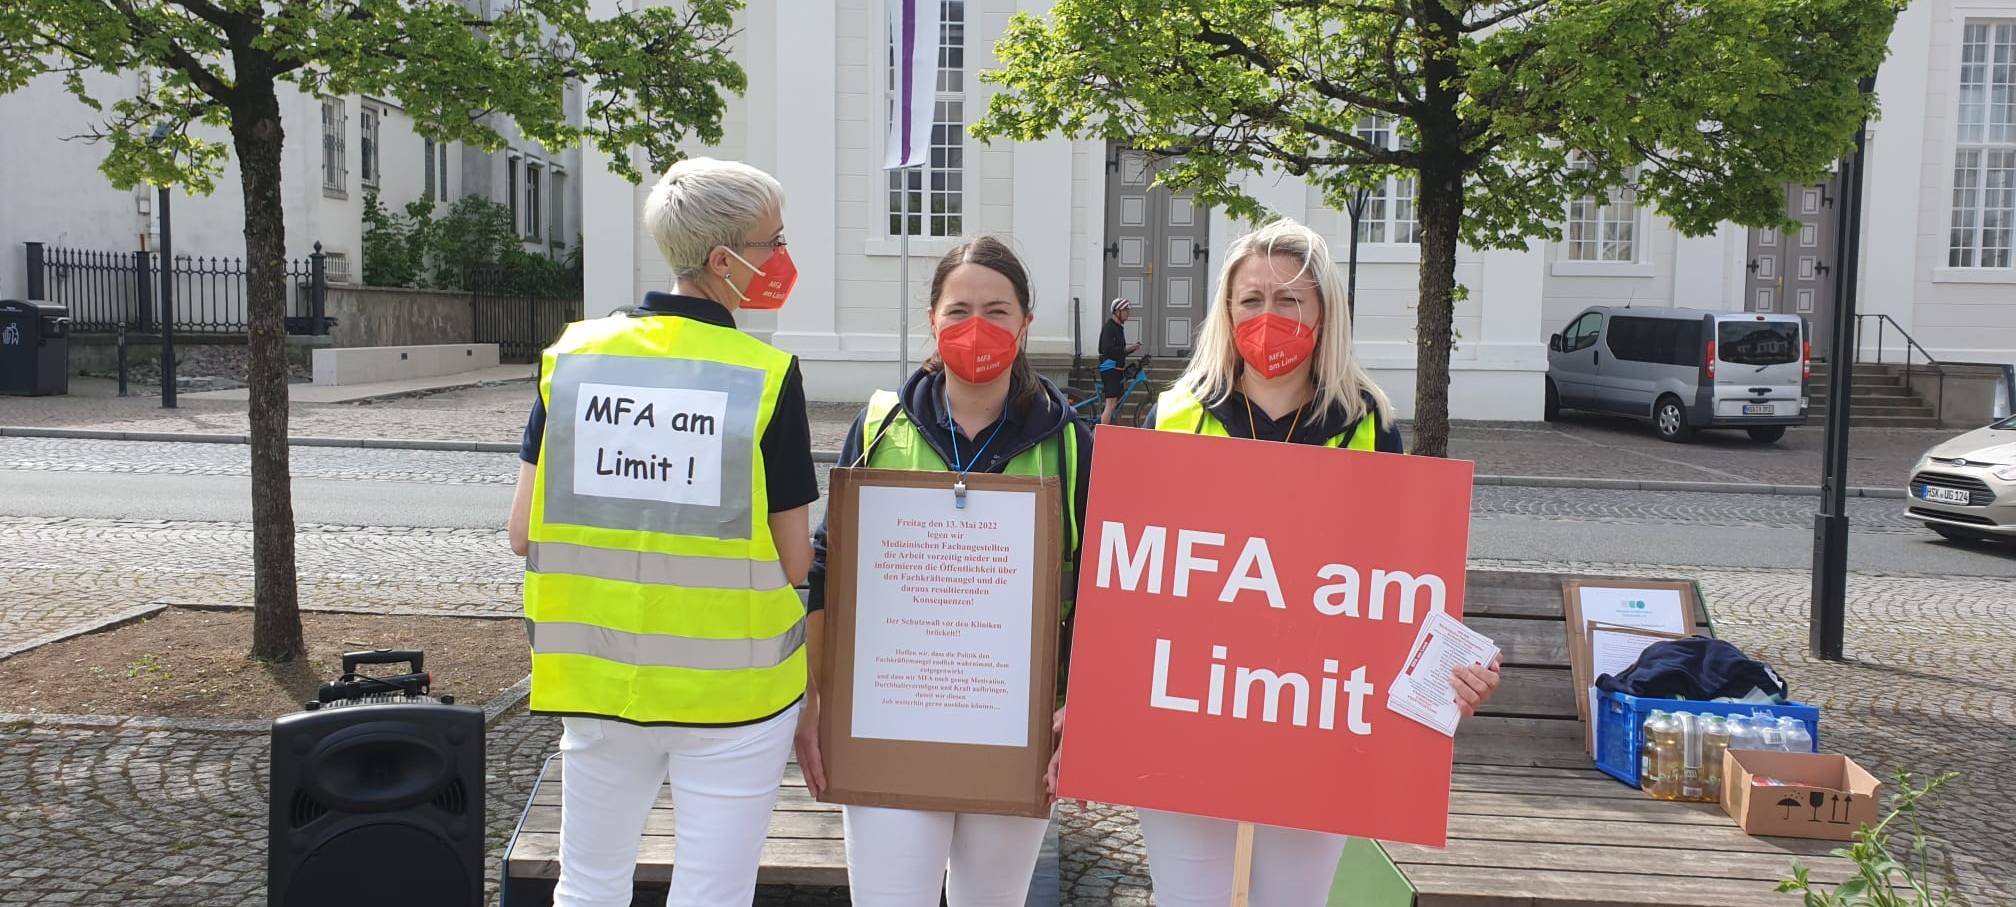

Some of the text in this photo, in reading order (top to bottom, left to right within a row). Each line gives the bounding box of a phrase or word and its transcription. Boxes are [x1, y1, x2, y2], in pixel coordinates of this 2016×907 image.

[1268, 351, 1284, 361] MFA
[585, 395, 714, 435] MFA am
[597, 447, 672, 482] Limit
[1955, 491, 1968, 502] 124
[897, 519, 926, 528] Freitag
[927, 531, 948, 540] legen
[881, 540, 1009, 552] Medizinischen Fachangestellten
[927, 553, 961, 563] vorzeitig
[874, 562, 922, 571] informieren
[940, 562, 996, 573] Öffentlichkeit
[1095, 520, 1447, 625] MFA am
[901, 574, 975, 584] Fachkräftemangel
[901, 585, 989, 595] daraus resultierenden
[913, 596, 974, 606] Konsequenzen!
[901, 618, 940, 626] Schutzwall
[971, 621, 1002, 629] Kliniken
[1150, 638, 1375, 736] Limit
